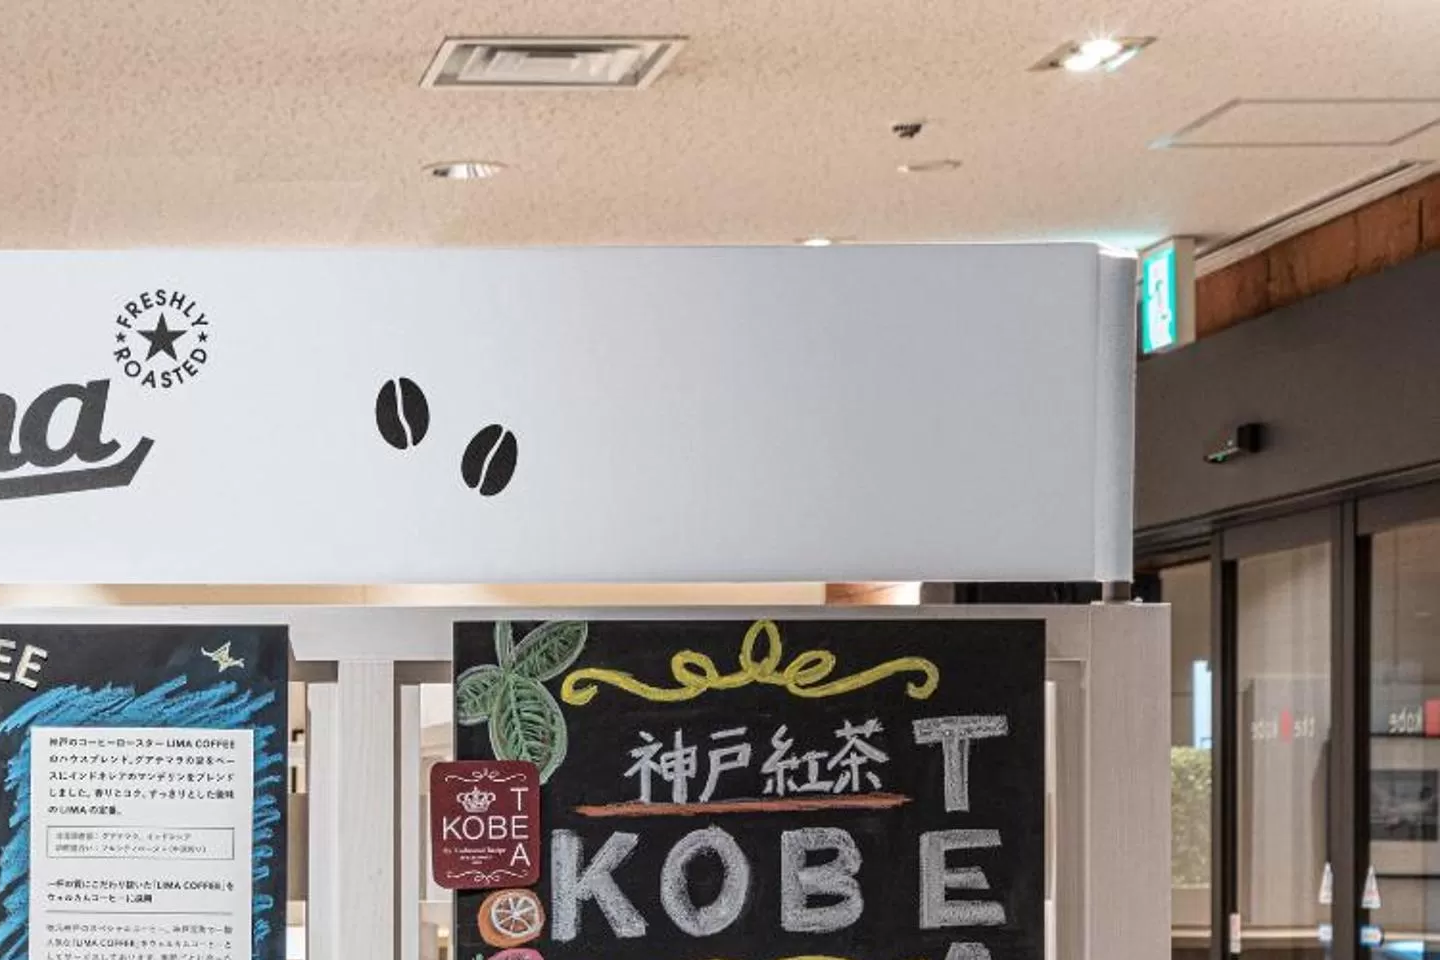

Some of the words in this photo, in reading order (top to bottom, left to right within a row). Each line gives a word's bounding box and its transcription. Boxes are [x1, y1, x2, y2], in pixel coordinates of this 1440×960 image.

[116, 289, 208, 329] FRESHLY
[113, 347, 207, 388] ROASTED
[166, 738, 193, 748] LIMA
[195, 738, 235, 749] COFFEE
[623, 718, 890, 803] 神戸紅茶
[442, 815, 529, 841] KOBE
